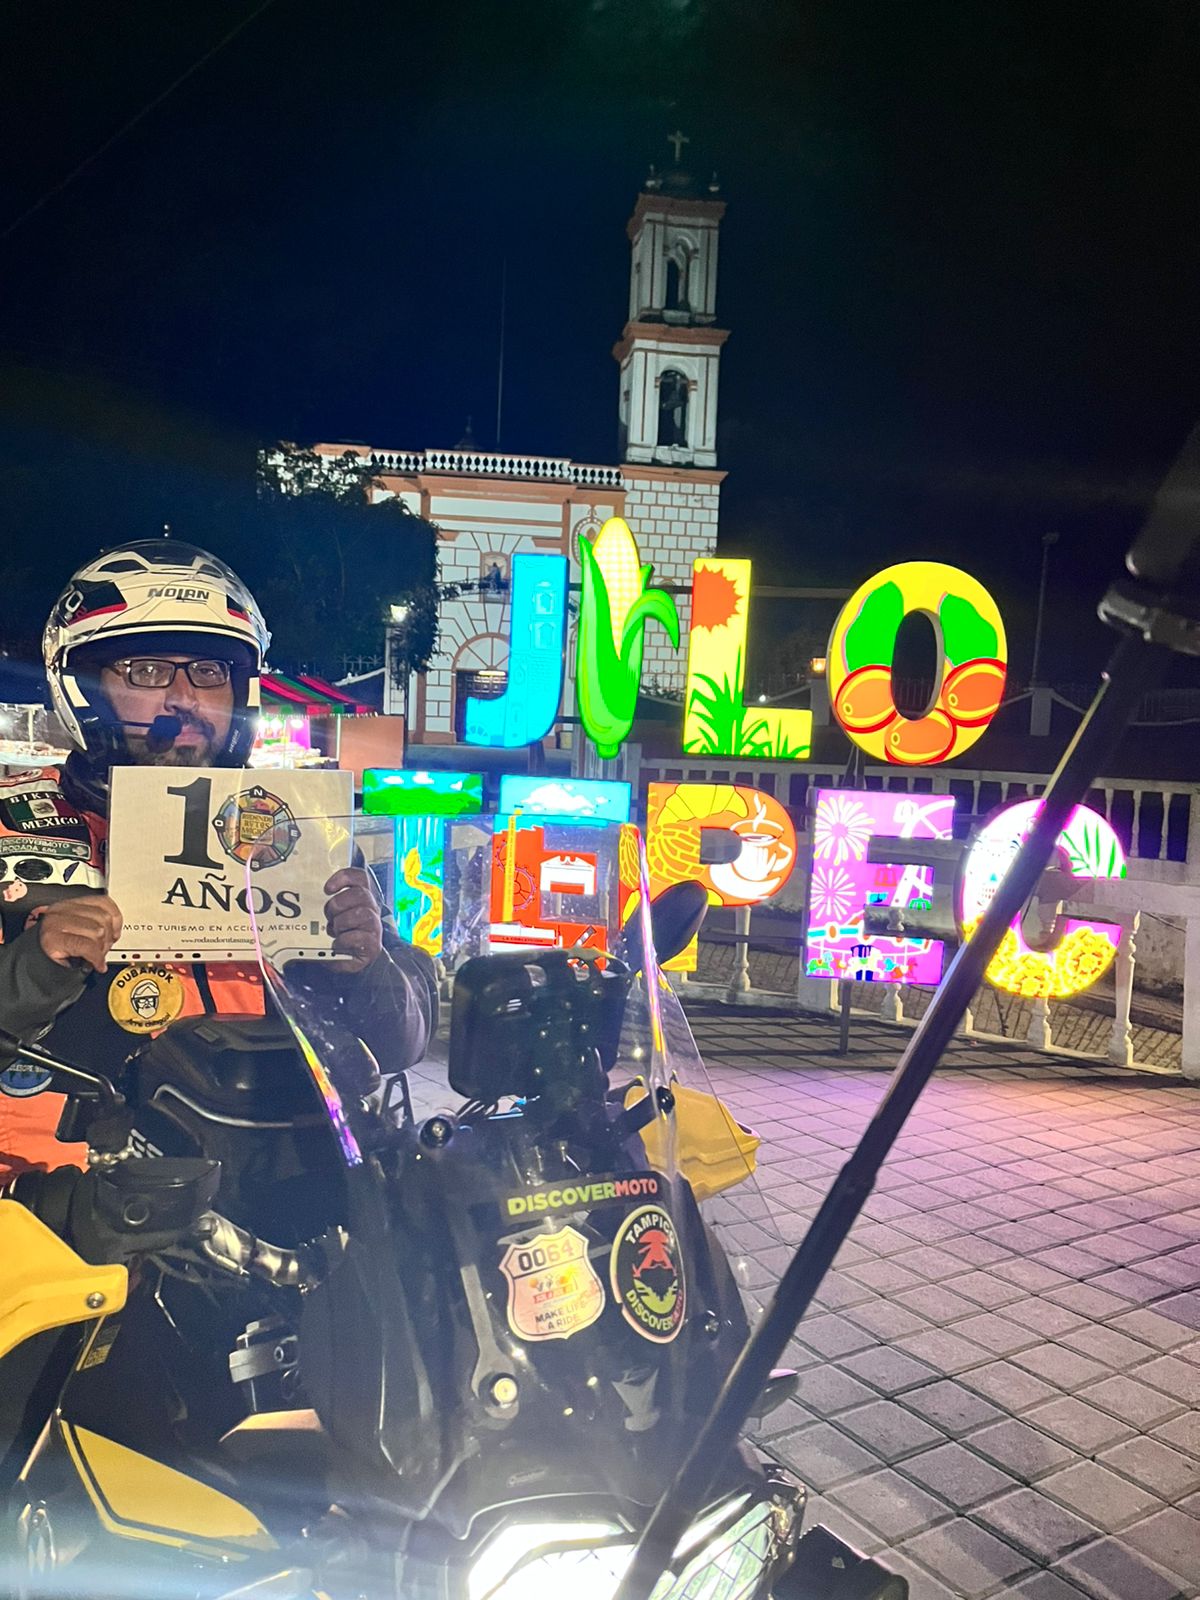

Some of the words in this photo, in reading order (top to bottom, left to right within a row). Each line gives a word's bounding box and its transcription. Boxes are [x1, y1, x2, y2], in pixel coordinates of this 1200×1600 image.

[147, 588, 210, 600] NOLAN
[21, 817, 79, 830] MEXICO
[161, 873, 302, 919] AÑOS
[158, 924, 205, 932] TURISMO
[116, 967, 174, 989] DUBANOK
[507, 1178, 658, 1216] DISCOVERMOTO
[625, 1213, 675, 1248] TAMPICO
[518, 1239, 575, 1272] 0064
[534, 1308, 564, 1323] MAKE
[566, 1300, 587, 1314] LIFE
[547, 1321, 555, 1330] A
